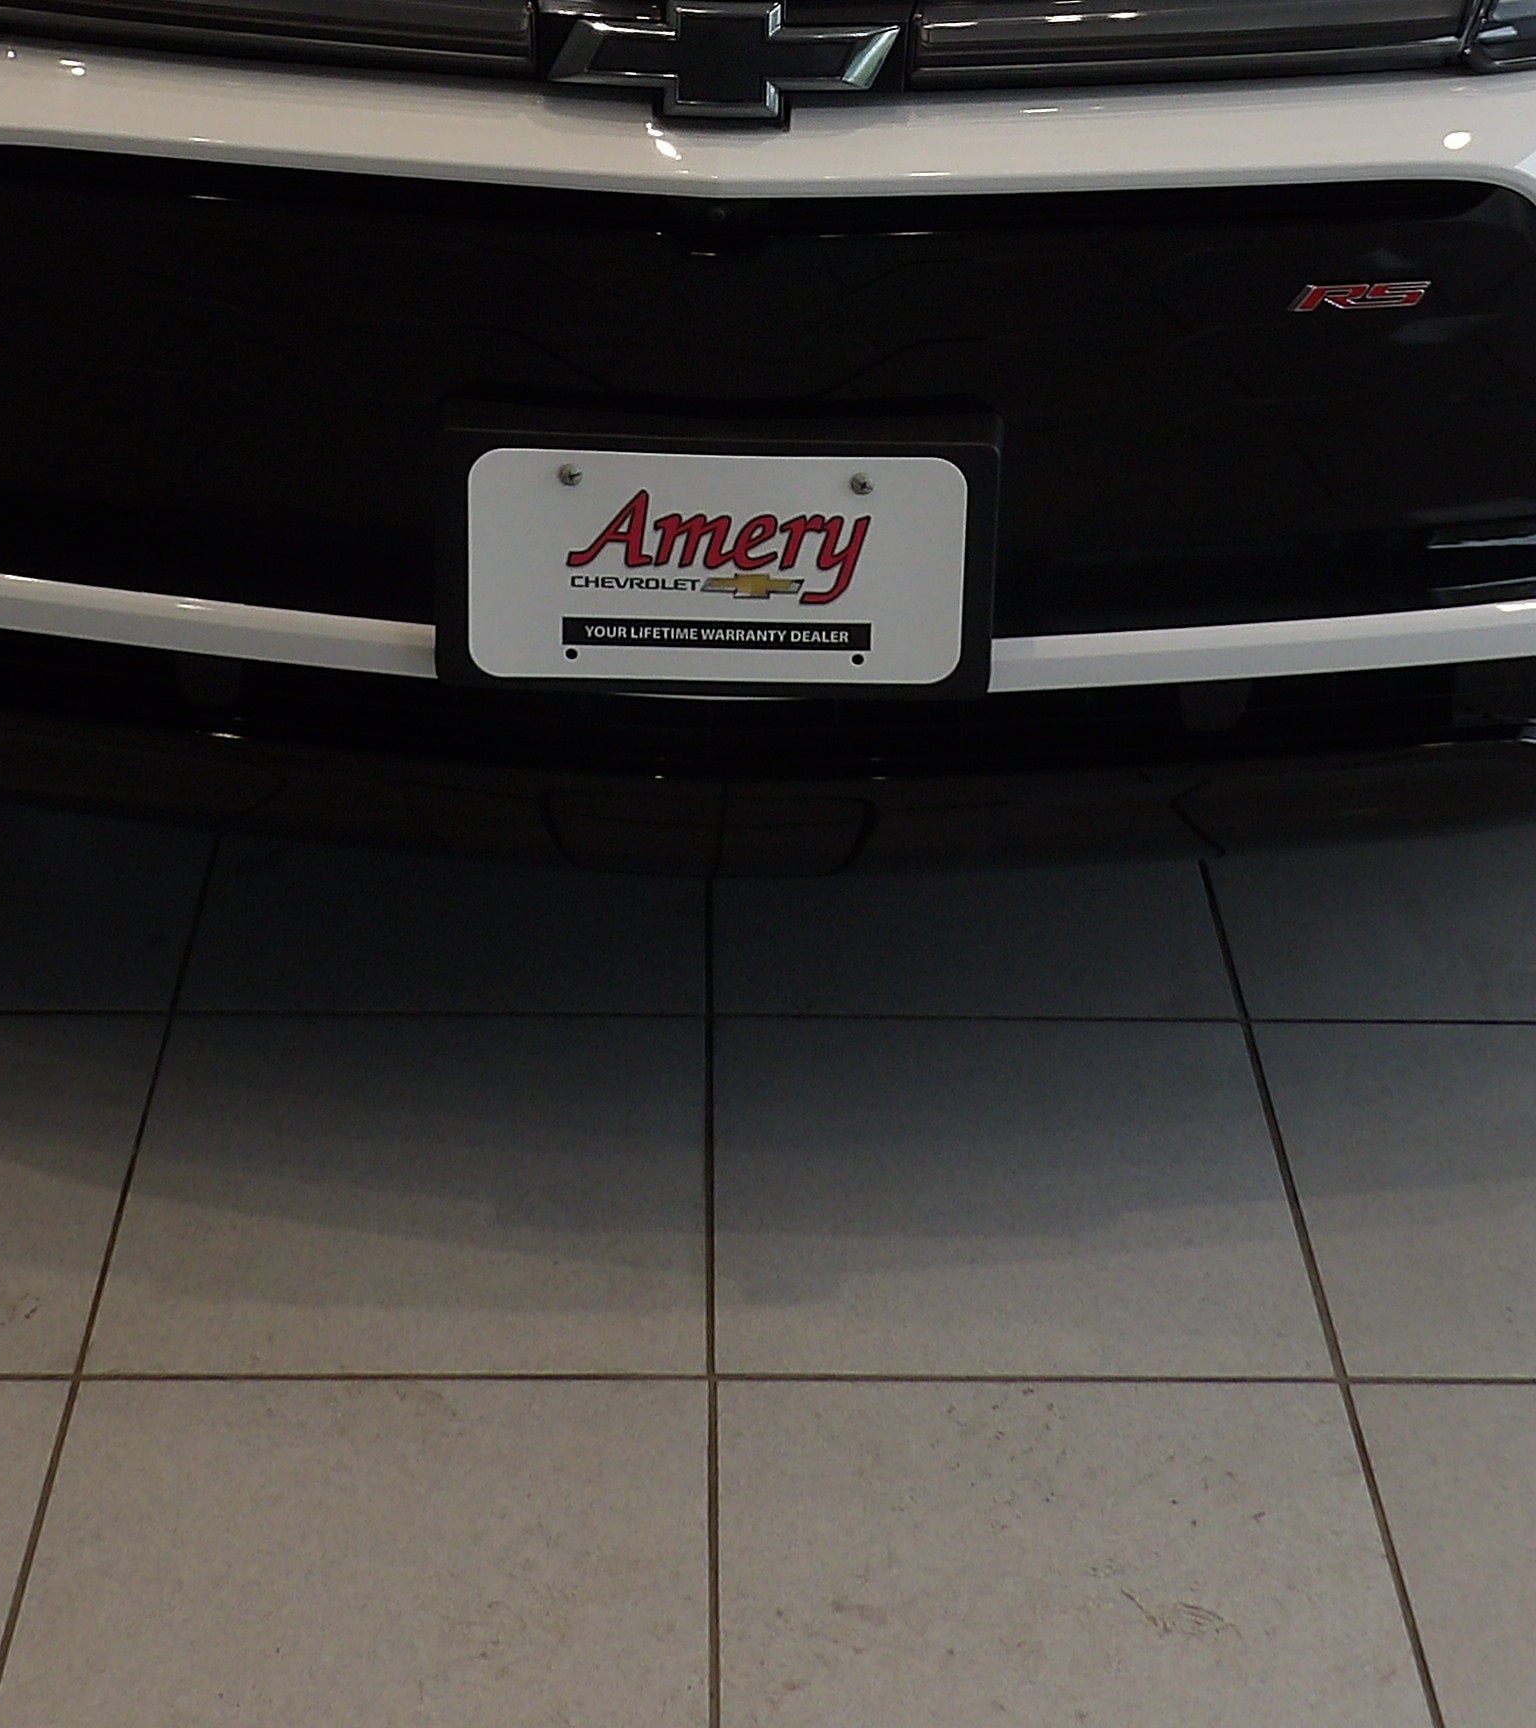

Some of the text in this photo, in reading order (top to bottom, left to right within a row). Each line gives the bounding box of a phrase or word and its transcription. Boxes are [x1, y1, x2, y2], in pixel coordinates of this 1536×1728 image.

[1288, 280, 1432, 313] RS
[565, 489, 871, 605] Amery
[570, 575, 701, 591] CHEVROLET
[584, 625, 850, 643] YOUR LIFETIME WARRANTY DEALER
